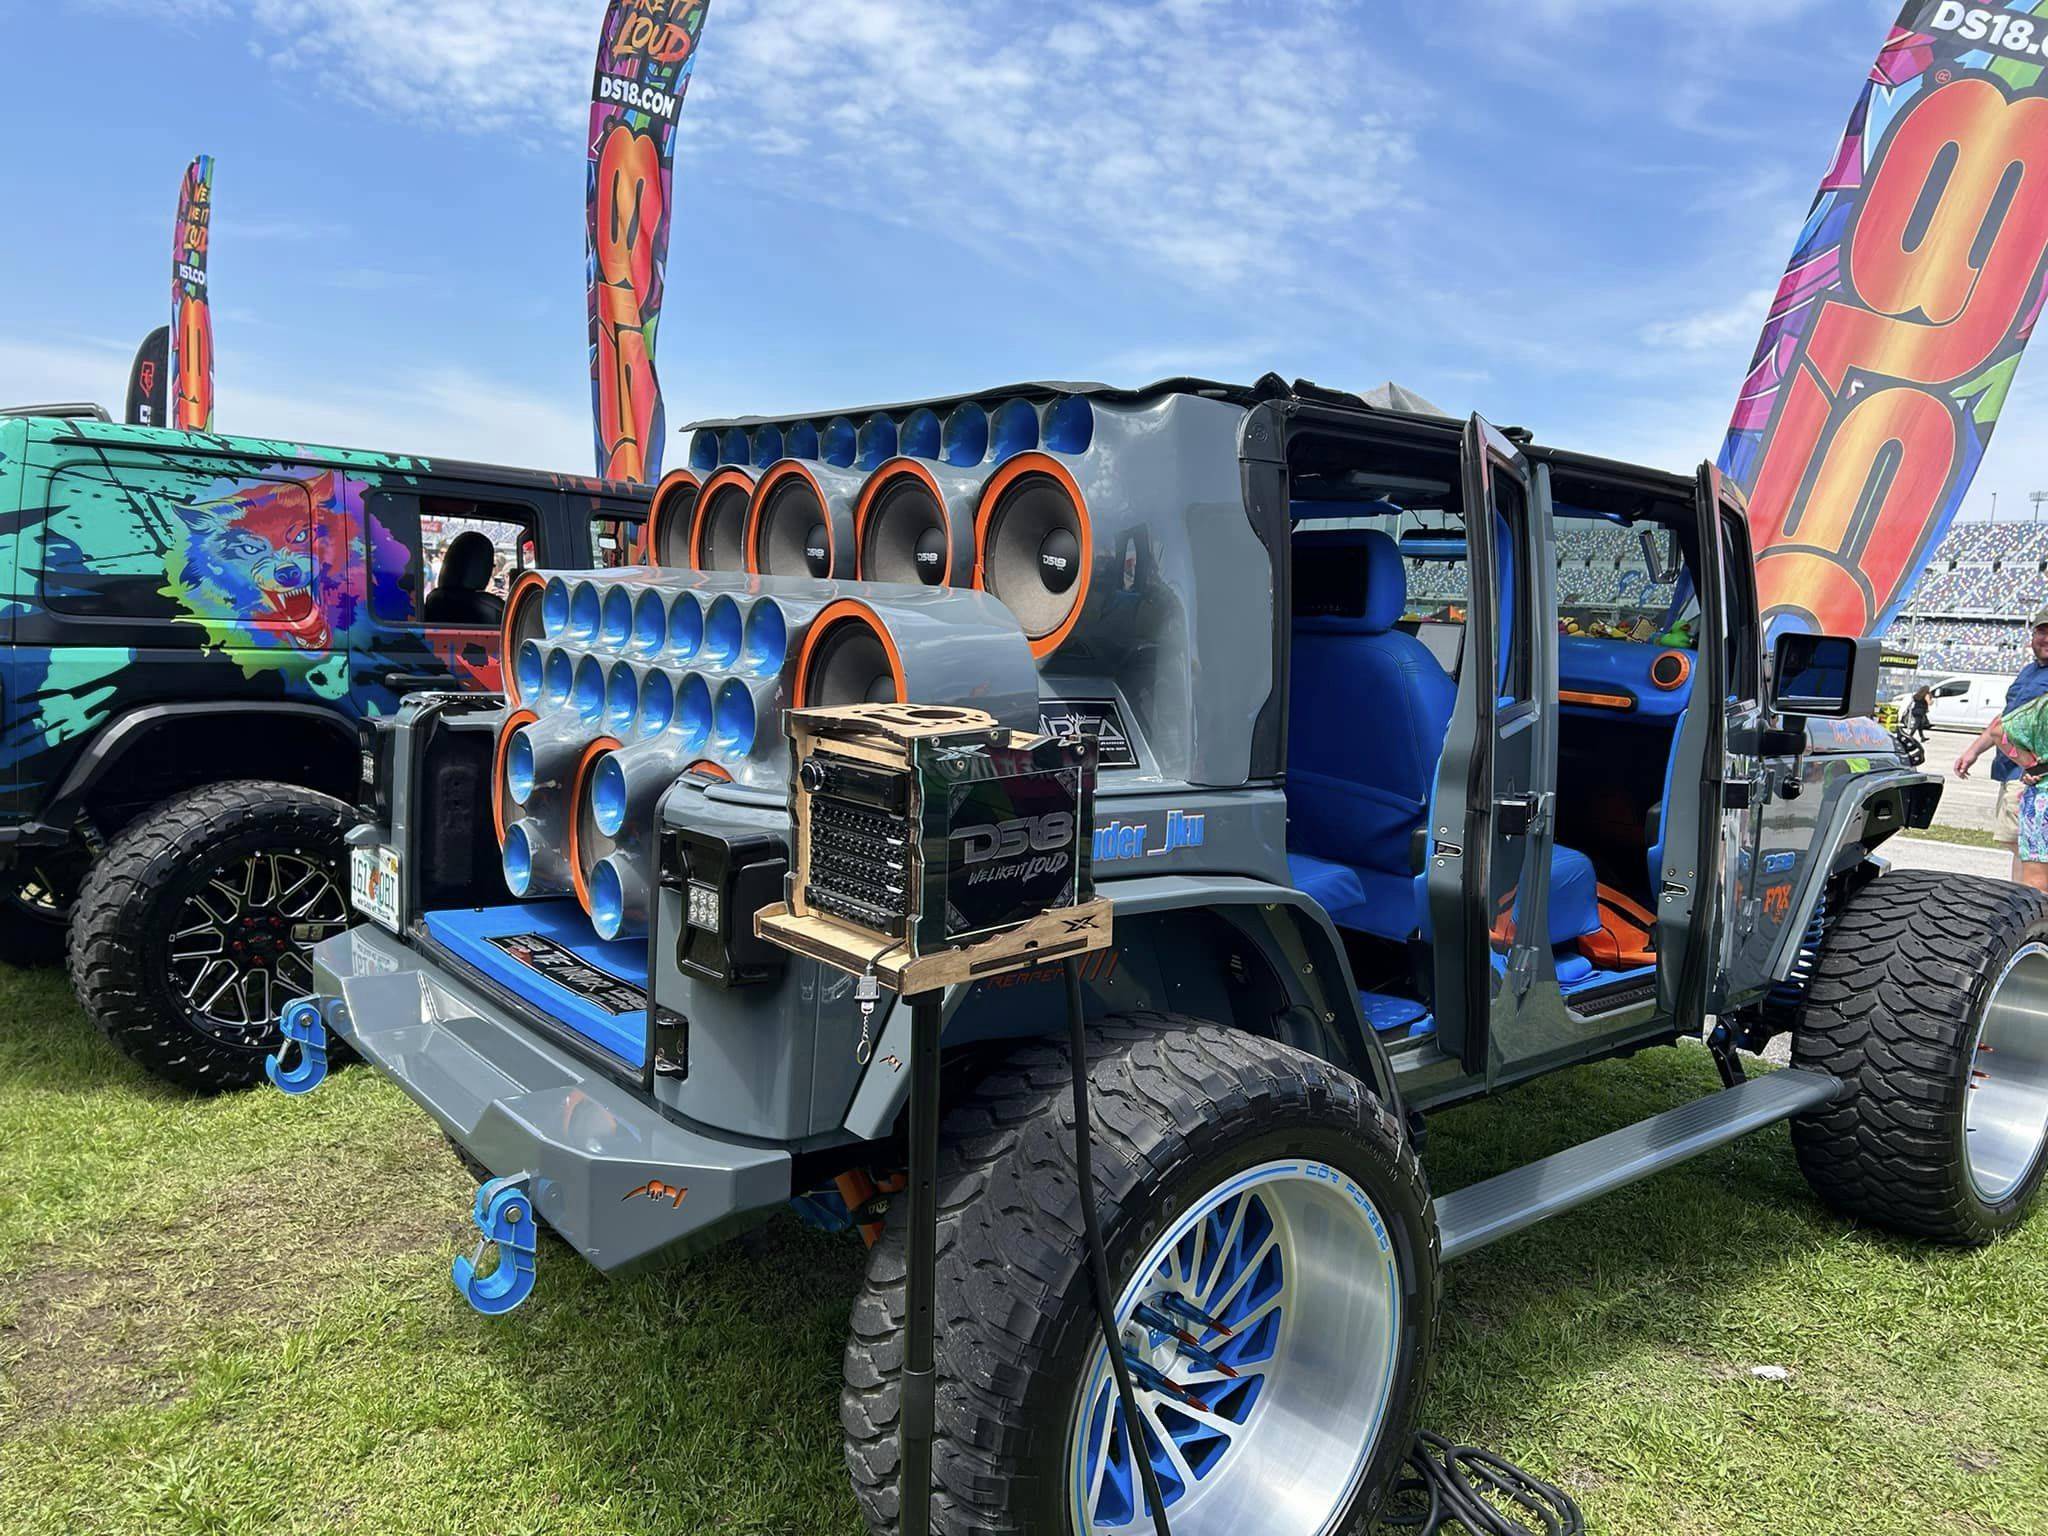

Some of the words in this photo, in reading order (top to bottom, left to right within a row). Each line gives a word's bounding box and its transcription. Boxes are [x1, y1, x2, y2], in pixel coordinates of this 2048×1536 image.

[612, 11, 691, 63] LOUD
[1930, 0, 2048, 58] DS18.
[600, 76, 676, 119] DS18.COM
[1041, 554, 1067, 568] DS18
[948, 810, 1075, 865] DS18
